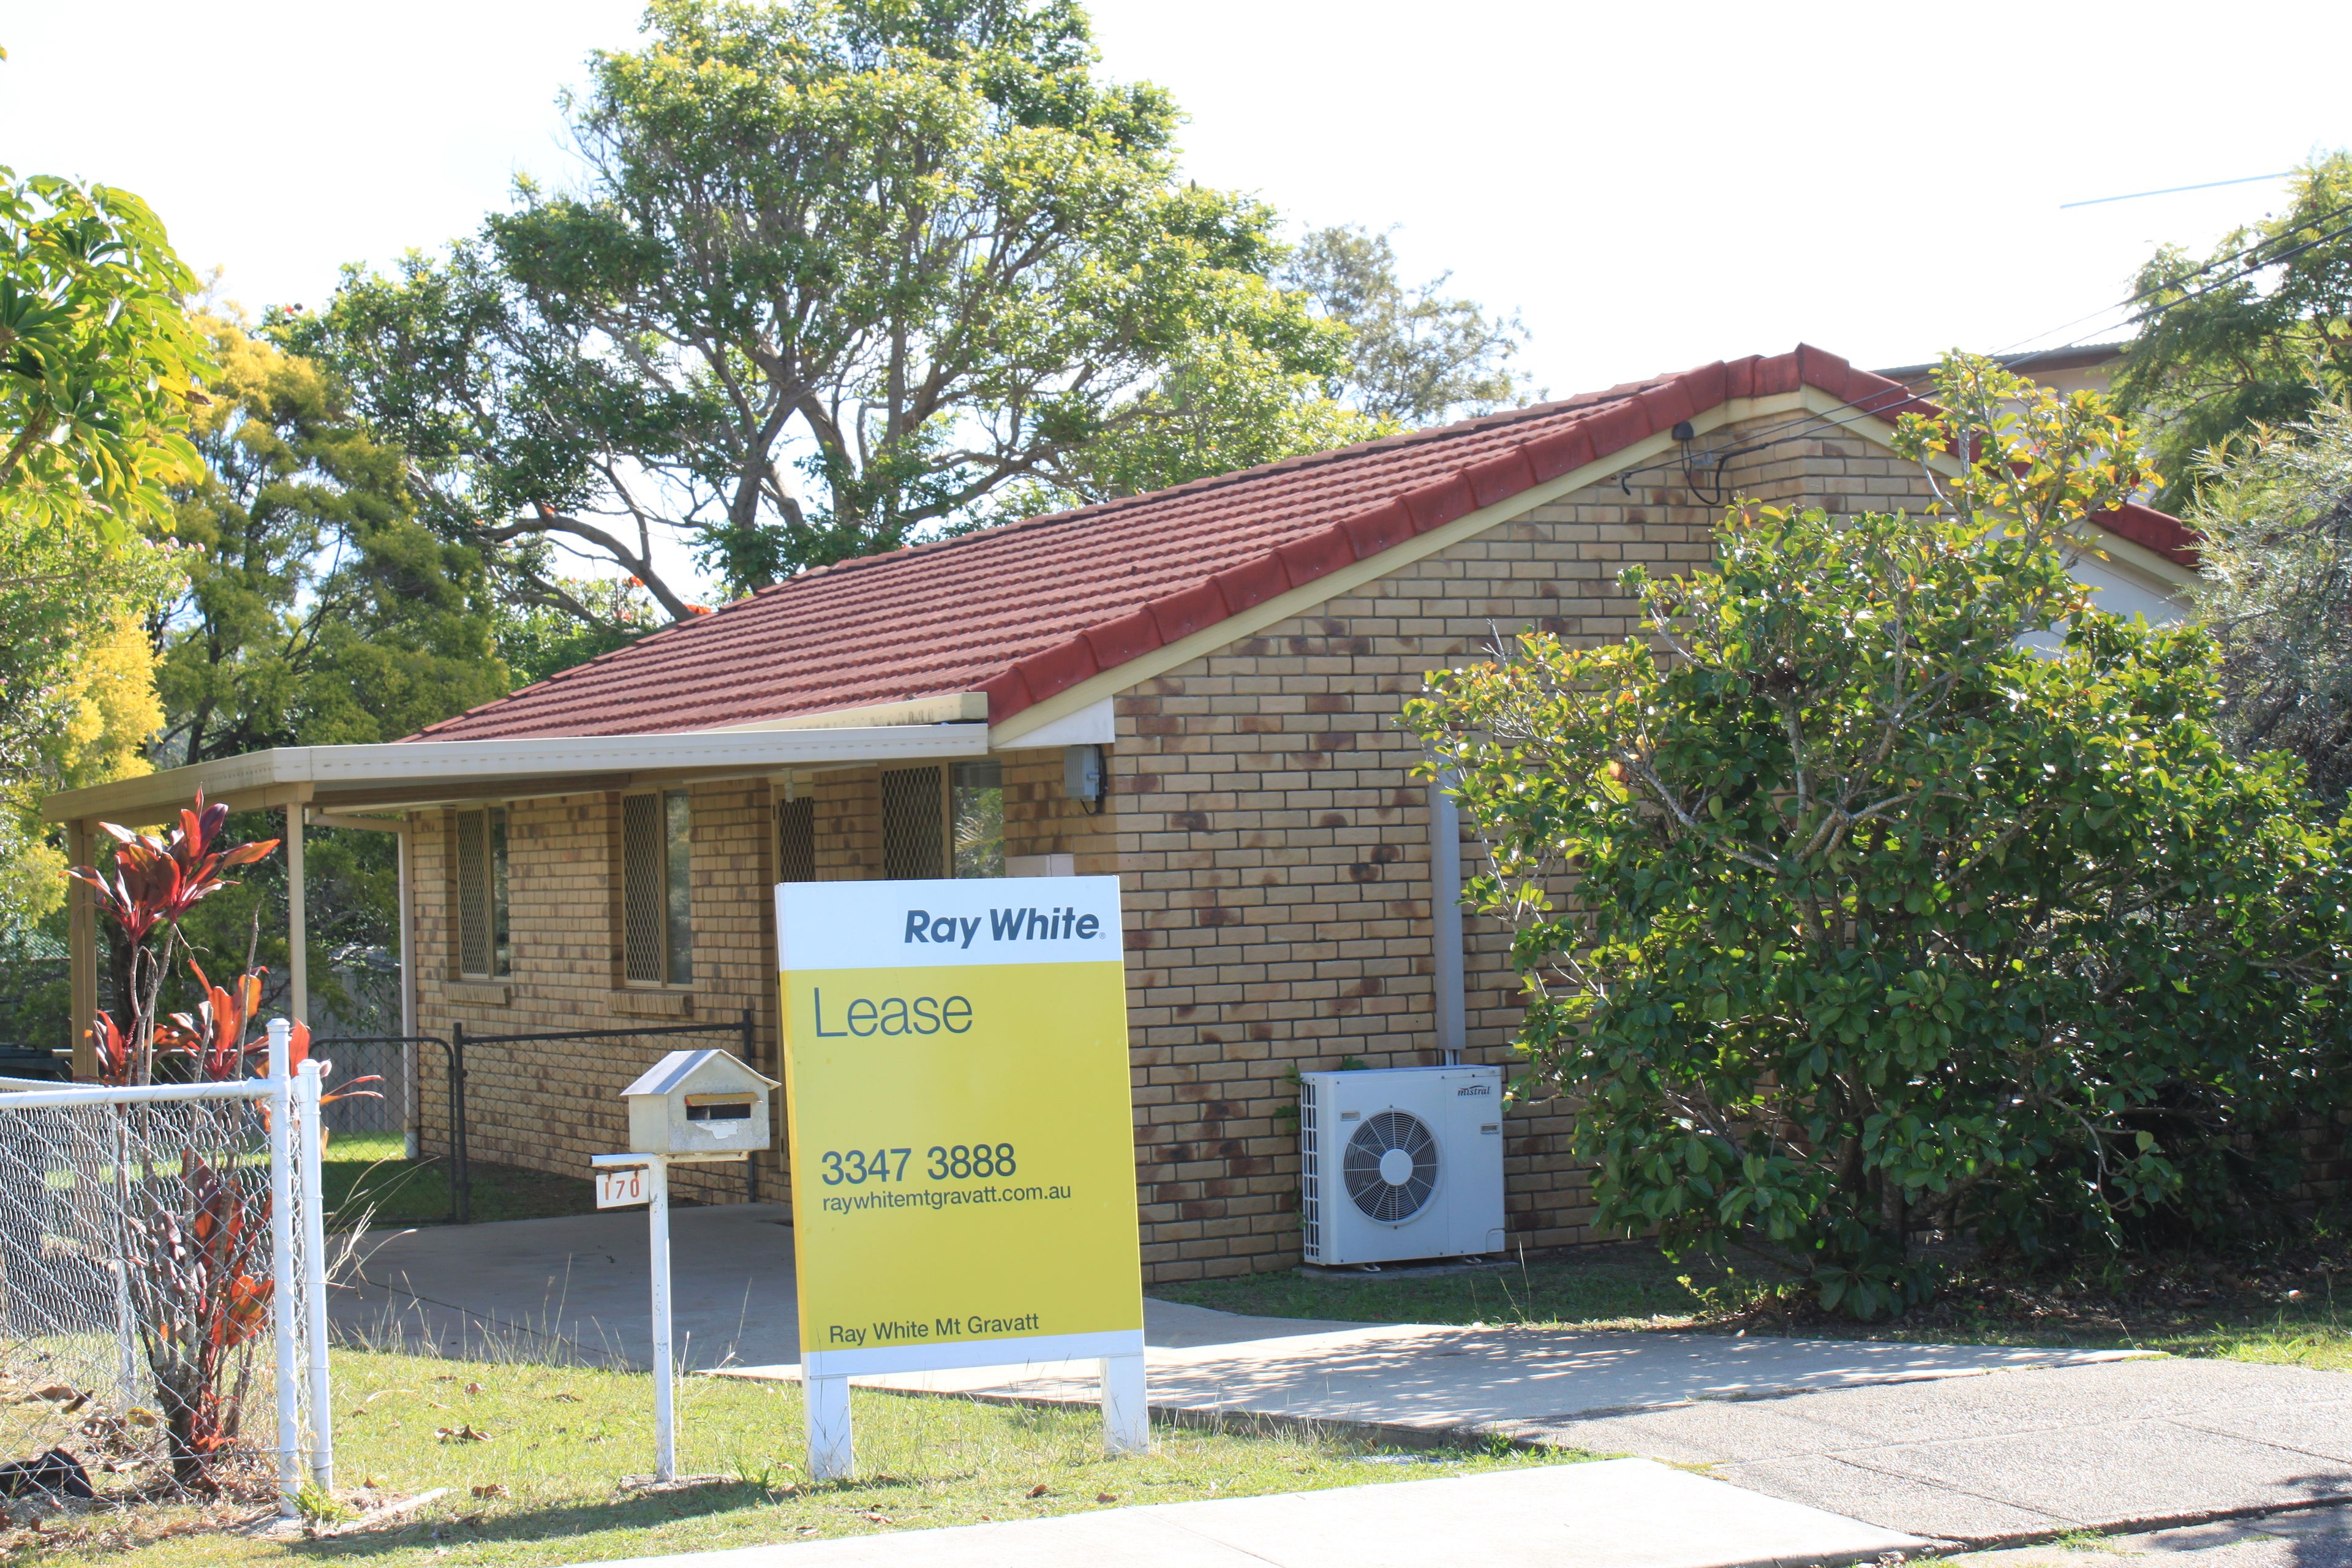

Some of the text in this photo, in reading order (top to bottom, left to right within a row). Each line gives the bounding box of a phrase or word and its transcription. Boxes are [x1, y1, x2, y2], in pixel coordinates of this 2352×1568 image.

[904, 907, 1099, 949] Ray White
[814, 987, 973, 1038] Lease
[1458, 1085, 1490, 1096] mistral
[821, 1142, 1017, 1186] 3347 3888
[605, 1177, 639, 1200] 170
[823, 1185, 1071, 1215] raywhitemtgravatt.com.au
[829, 1313, 1039, 1346] Ray White Mt Gravatt
